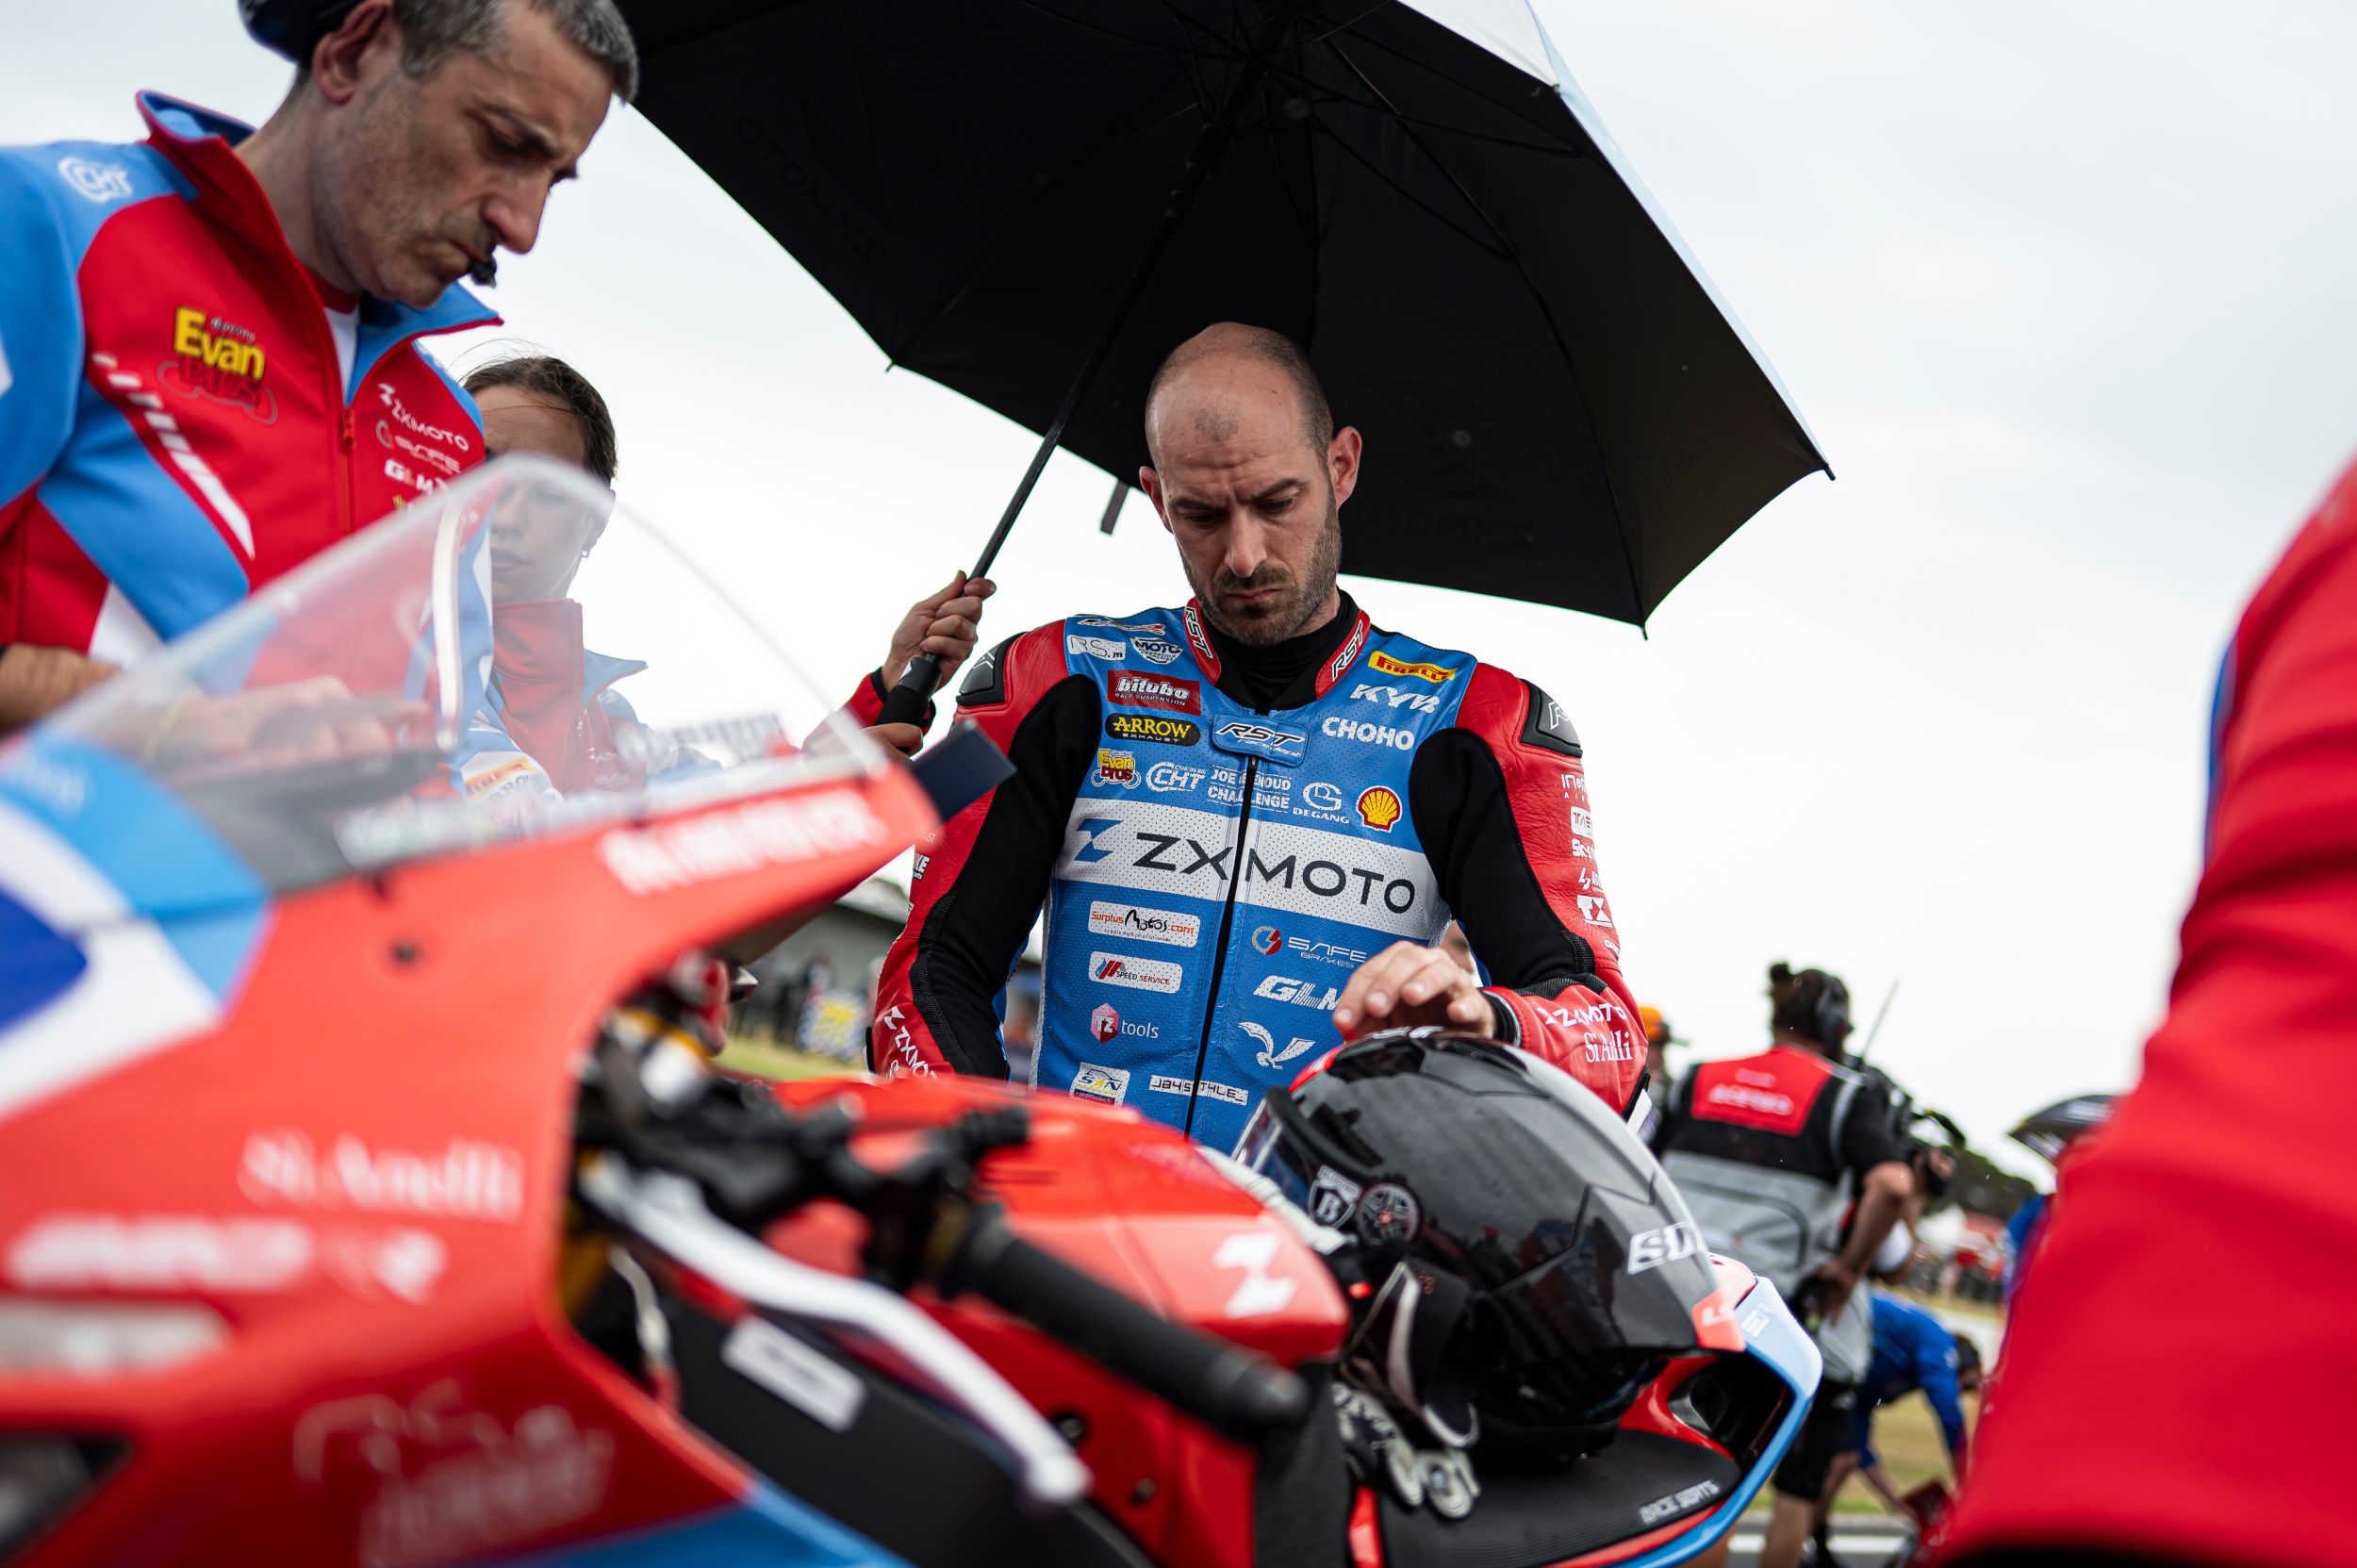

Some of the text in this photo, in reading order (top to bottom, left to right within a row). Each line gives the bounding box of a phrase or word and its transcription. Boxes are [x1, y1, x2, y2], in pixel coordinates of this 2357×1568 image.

[174, 305, 265, 380] Evan
[391, 398, 470, 452] ZXMOTO
[1185, 606, 1214, 659] RST
[1133, 640, 1181, 653] MOTO
[1331, 619, 1363, 682] RST
[1376, 655, 1449, 681] PIRELLI
[1116, 676, 1190, 700] bitubo
[1135, 693, 1186, 706] SUSPENSION
[1350, 684, 1440, 714] KYB
[1113, 717, 1191, 738] ARROW
[1122, 733, 1179, 743] EXHAUST
[1215, 722, 1306, 746] RST
[1322, 717, 1414, 751] CHOHO
[1097, 749, 1135, 770] Evan
[1149, 766, 1206, 790] CHT
[1211, 768, 1237, 785] JOE
[1293, 807, 1350, 824] DEGANG
[1131, 832, 1415, 914] ZXMOTO
[1288, 936, 1367, 963] SAFE
[1300, 951, 1355, 968] BRAKES
[1116, 970, 1170, 985] SPEED SERVICE
[1096, 1015, 1160, 1039] TZ tools
